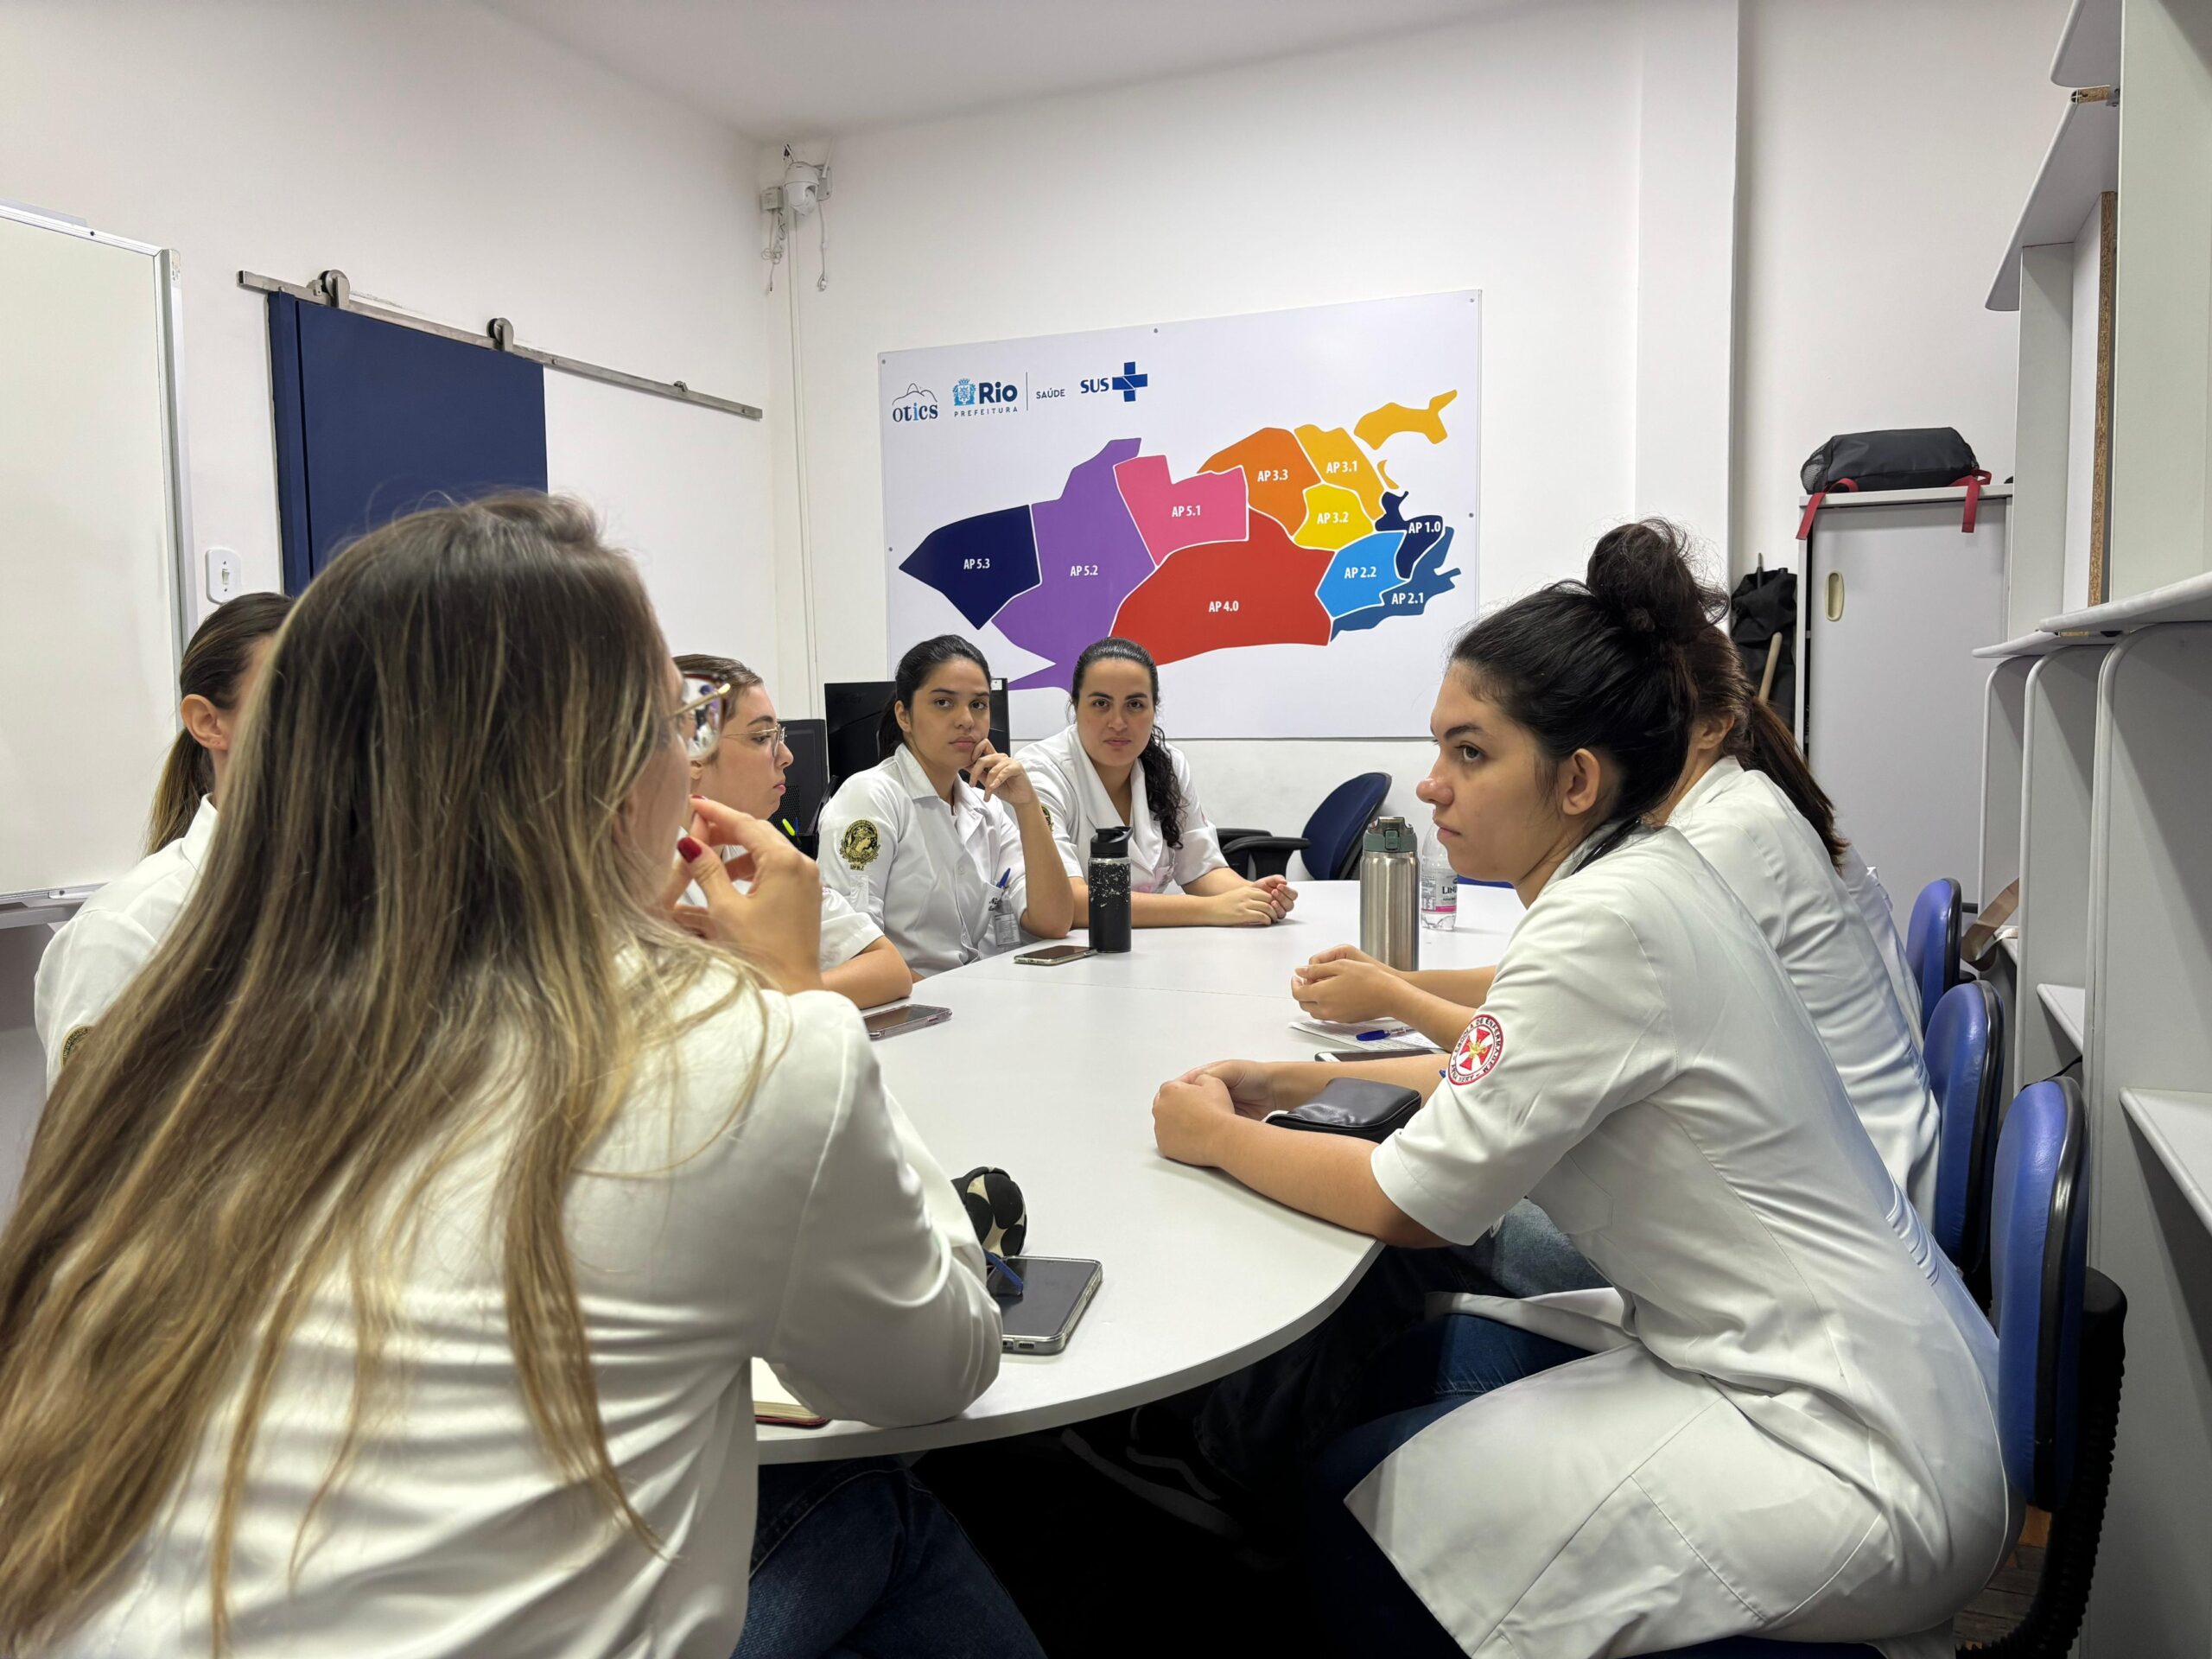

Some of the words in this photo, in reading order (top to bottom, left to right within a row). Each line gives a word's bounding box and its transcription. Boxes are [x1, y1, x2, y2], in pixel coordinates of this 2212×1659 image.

[1080, 377, 1109, 394] SUS
[978, 381, 1018, 404] Rio
[1036, 387, 1065, 399] SAÚDE
[892, 402, 939, 423] otics
[953, 406, 1018, 417] PREFEITURA
[1326, 461, 1340, 474] AP
[1342, 461, 1357, 473] 3.1
[1257, 470, 1271, 481] AP
[1273, 469, 1288, 480] 3.3
[1172, 505, 1185, 517] AP
[1186, 505, 1200, 516] 5.1
[1317, 512, 1331, 524] AP
[1333, 512, 1348, 523] 3.2
[1408, 522, 1422, 533] AP
[1425, 521, 1440, 532] 1.0
[963, 559, 975, 569] AP
[977, 558, 989, 569] 5.3
[1071, 566, 1082, 576] AP
[1084, 565, 1098, 575] 5.2
[1344, 567, 1358, 579] AP
[1360, 567, 1376, 578] 2.2
[1392, 593, 1406, 604] AP
[1408, 593, 1423, 604] 2.1
[1209, 601, 1222, 612] AP
[1224, 601, 1238, 611] 4.0
